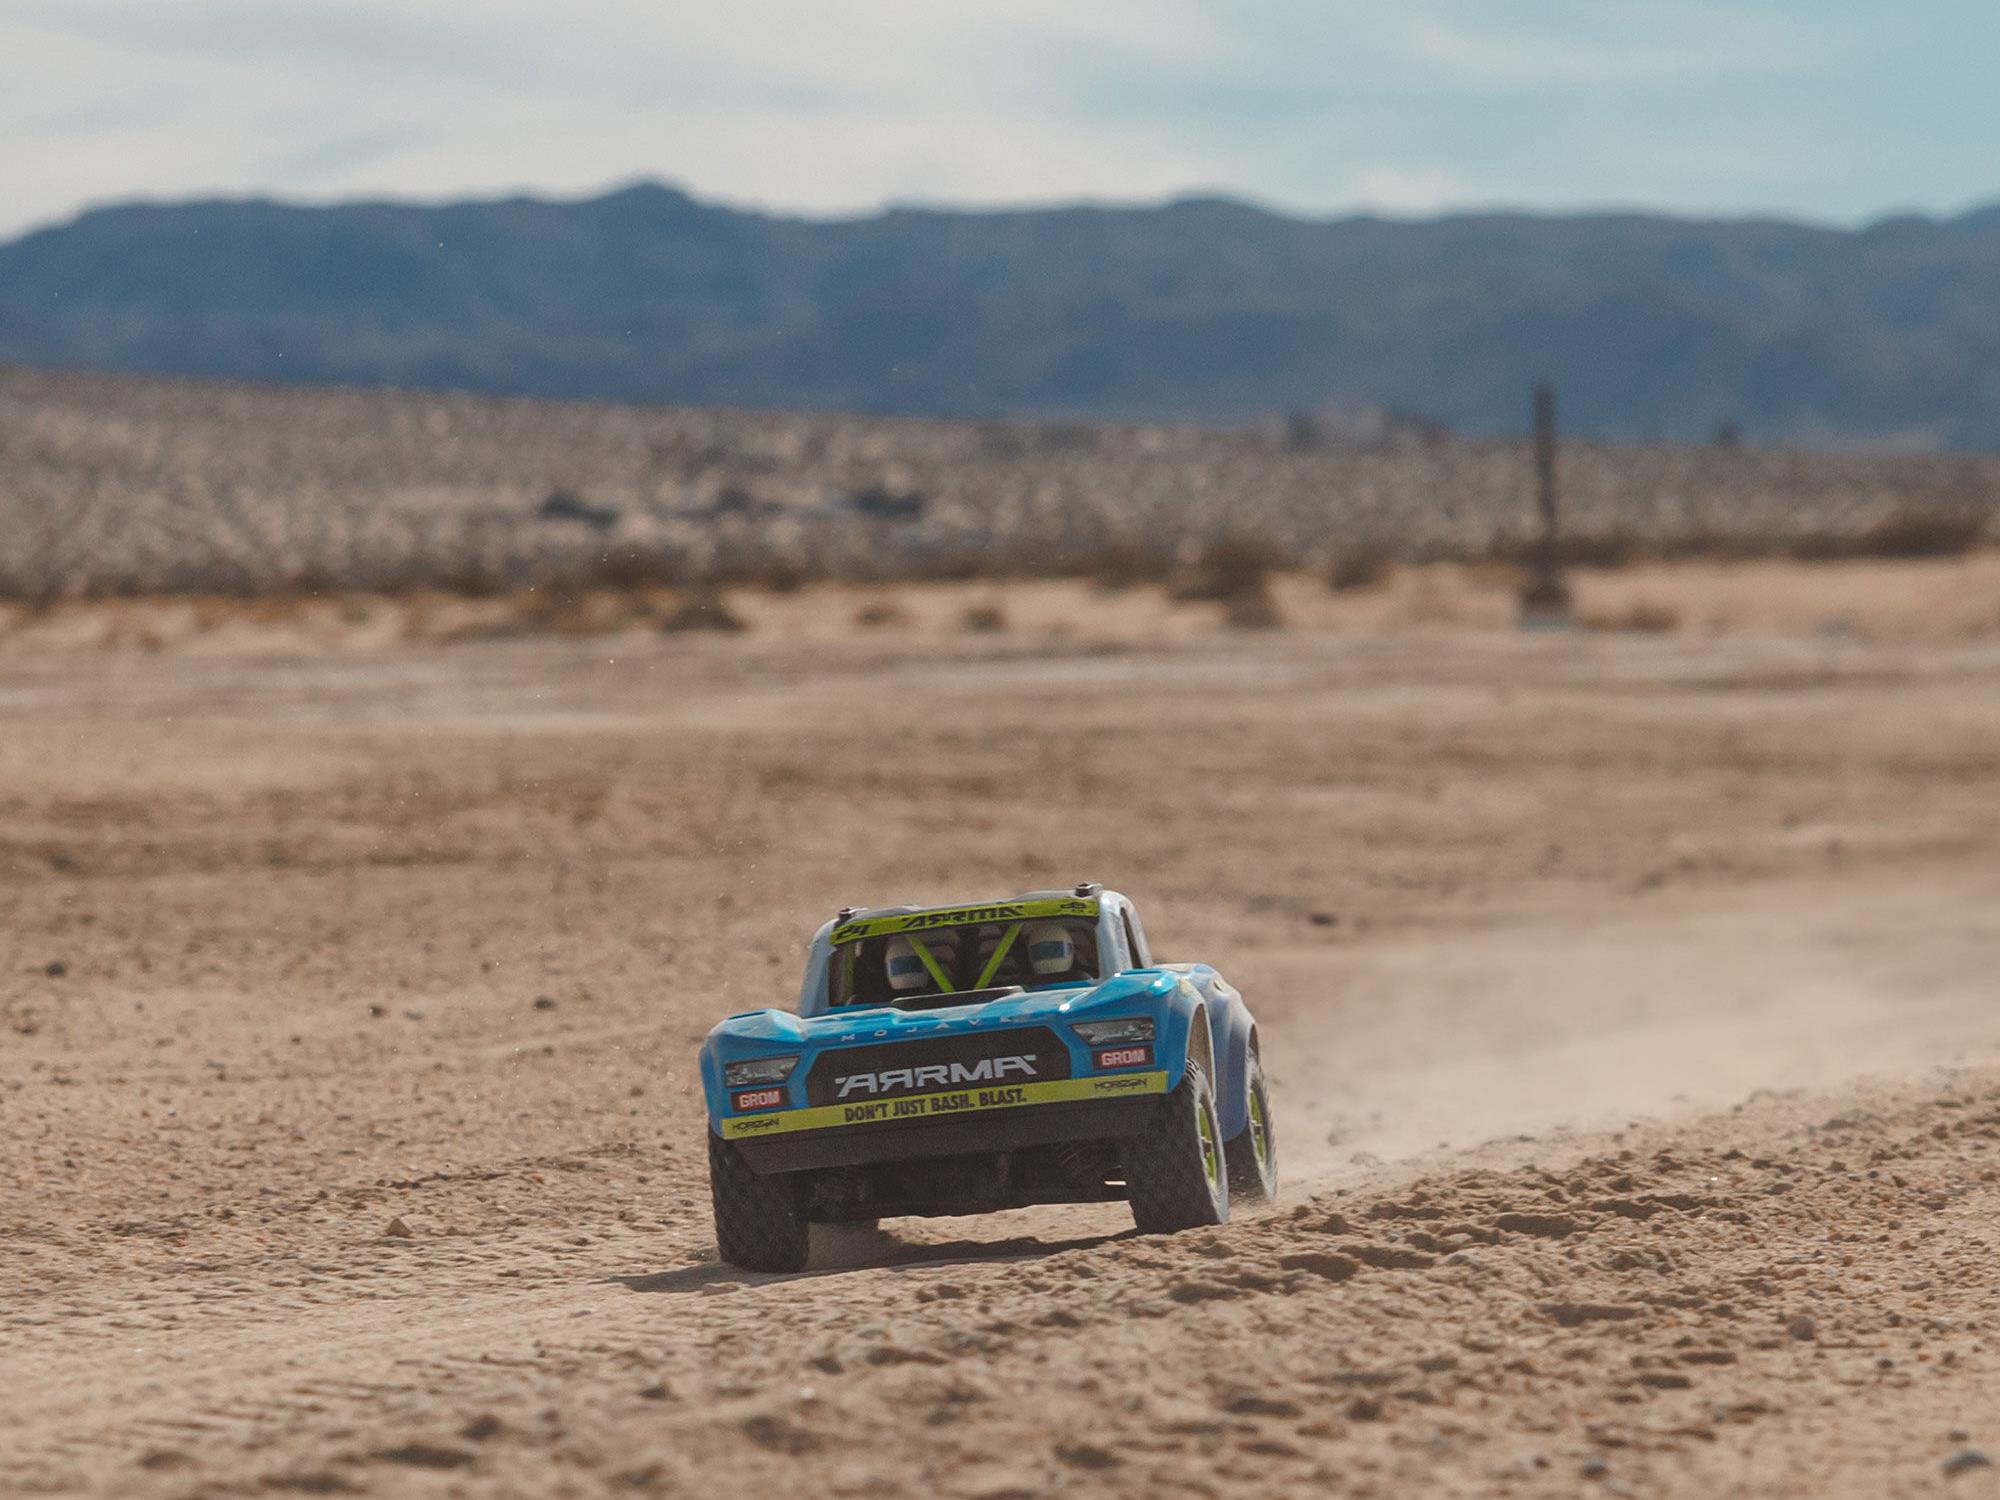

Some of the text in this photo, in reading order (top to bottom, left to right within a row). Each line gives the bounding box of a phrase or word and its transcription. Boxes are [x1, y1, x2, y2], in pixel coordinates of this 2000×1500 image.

[1101, 1048, 1145, 1066] GROM
[834, 1054, 1037, 1098] ARRMA
[740, 1090, 780, 1108] GROM
[844, 1087, 1027, 1122] DON'T JUST BASH. BLAST.
